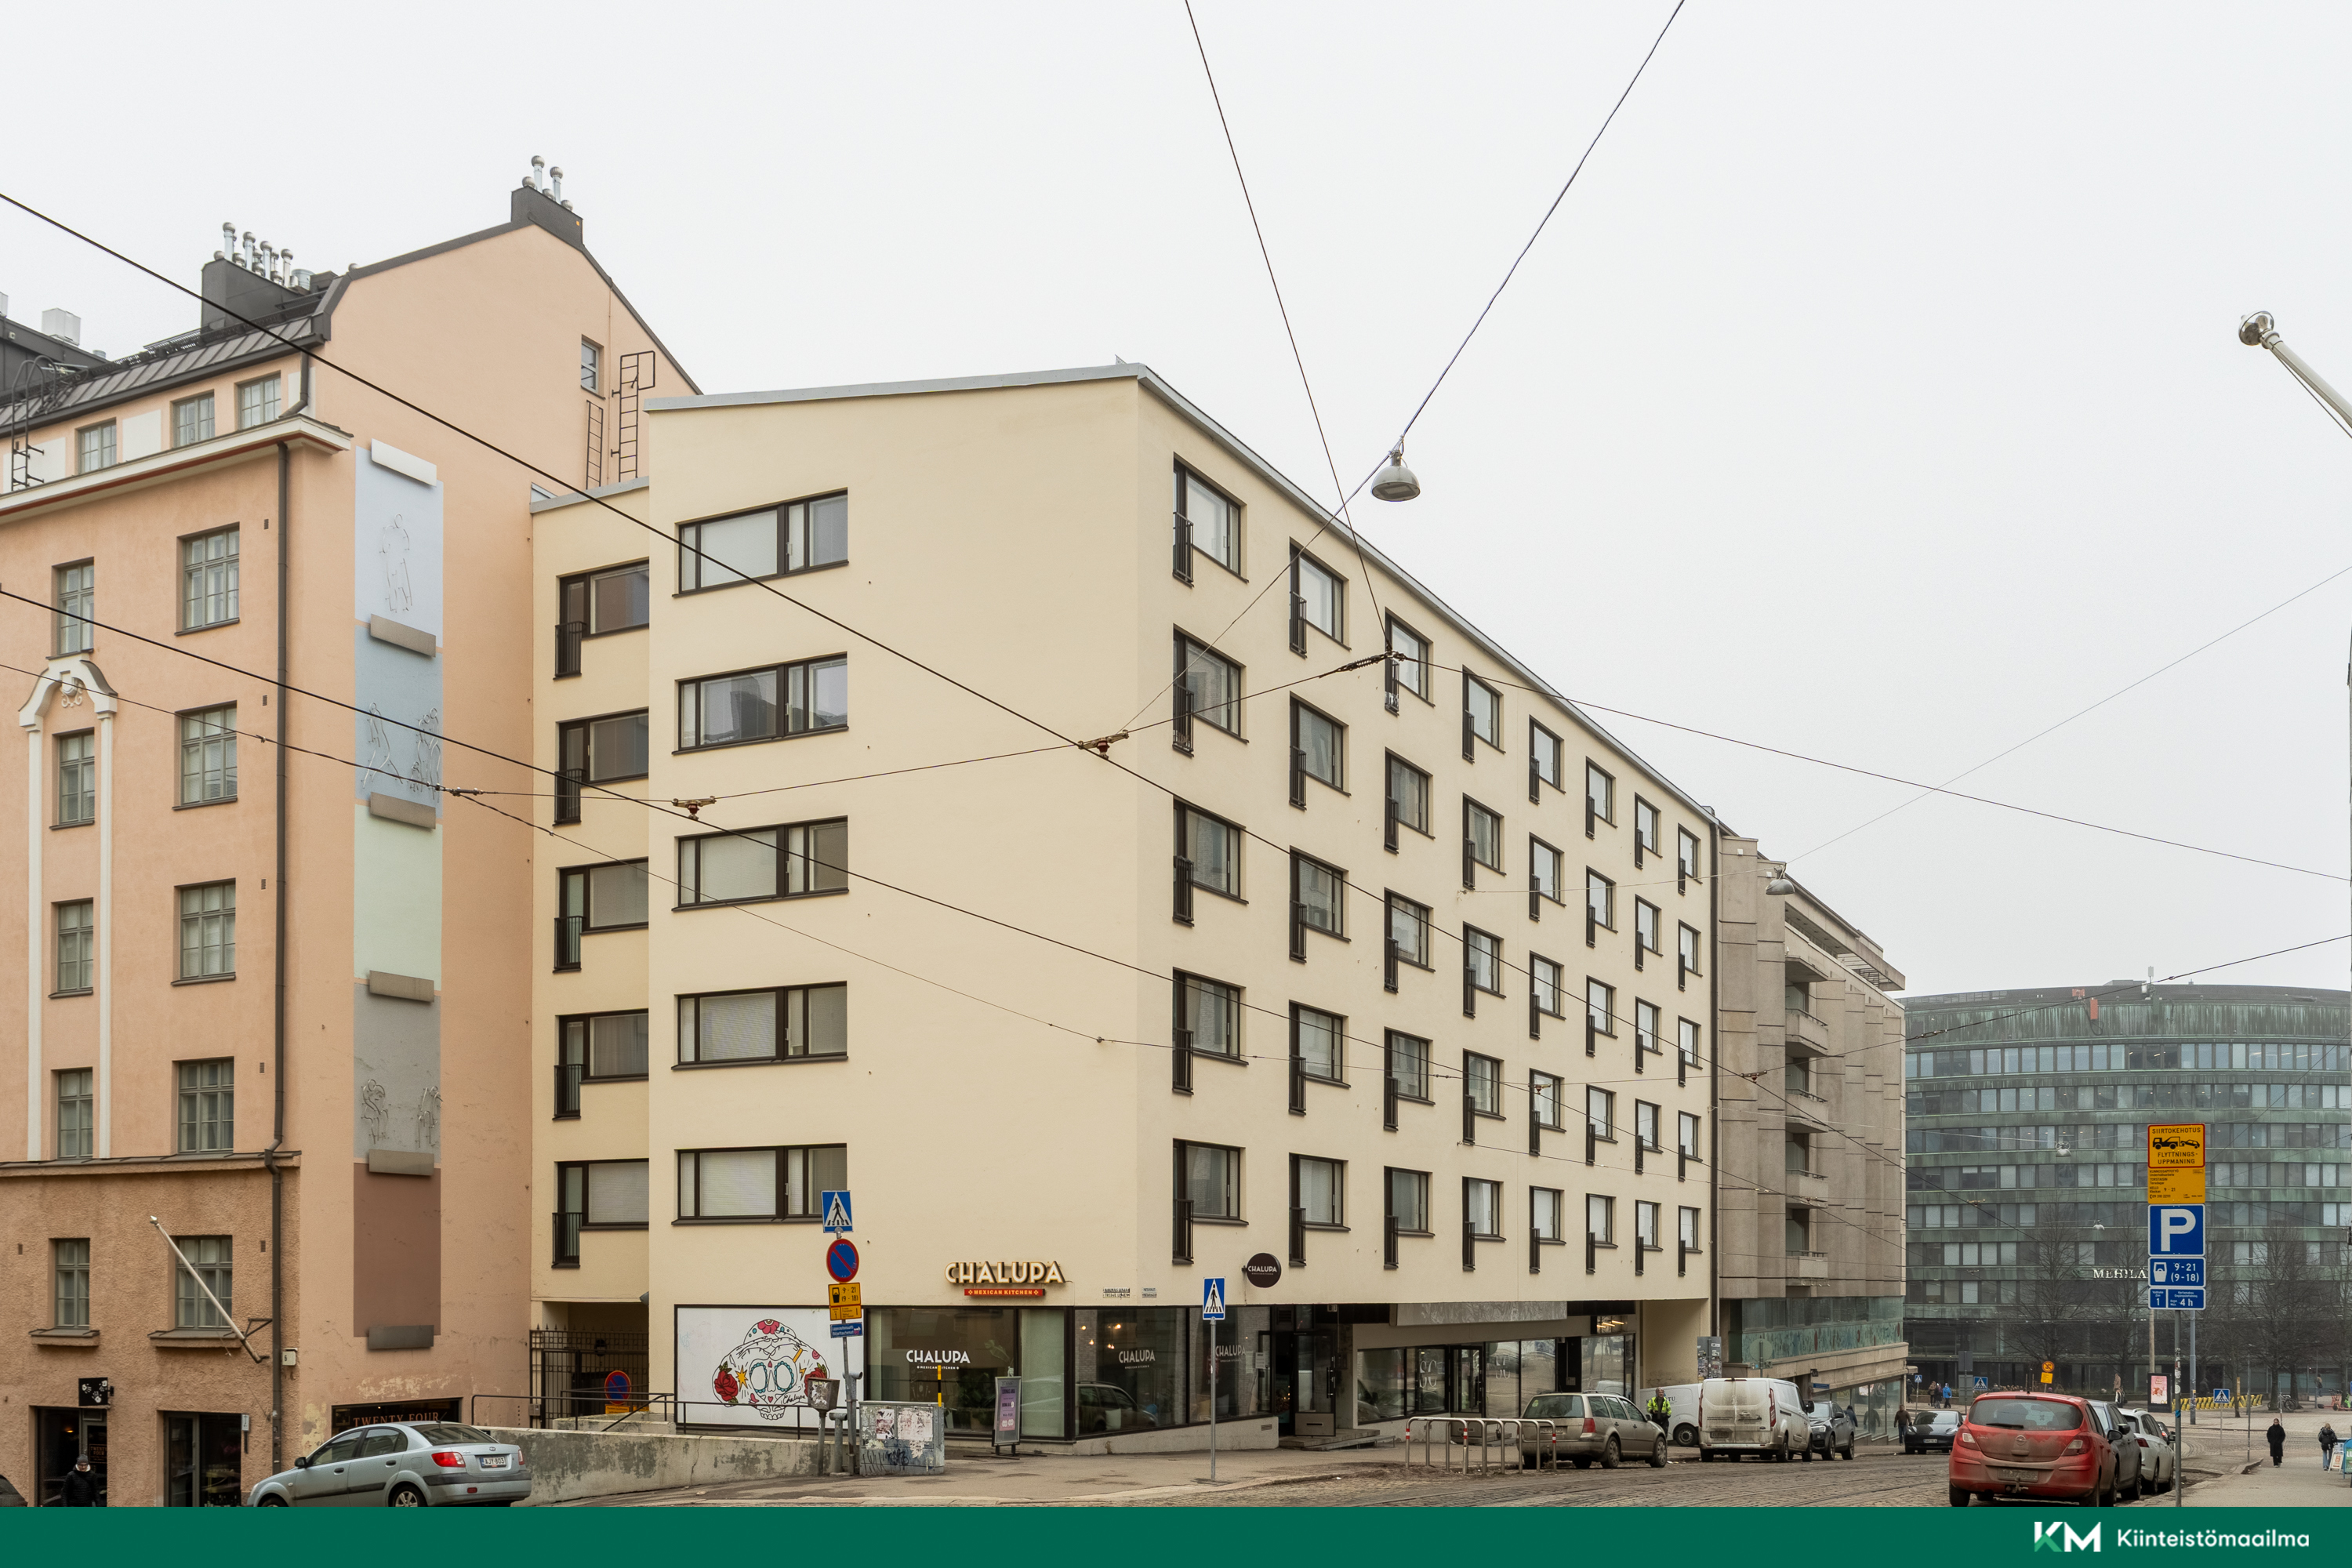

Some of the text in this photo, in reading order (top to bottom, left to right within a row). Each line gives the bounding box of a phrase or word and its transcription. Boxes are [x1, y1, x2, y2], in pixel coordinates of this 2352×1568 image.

[2161, 1209, 2196, 1251] P
[945, 1261, 1065, 1283] CHALUPA
[2093, 1267, 2148, 1279] MEHILÄ
[906, 1350, 971, 1363] CHALUPA
[1119, 1350, 1155, 1363] CHALUPA
[1216, 1345, 1246, 1356] CHALUPA
[353, 1414, 403, 1427] TWENTY
